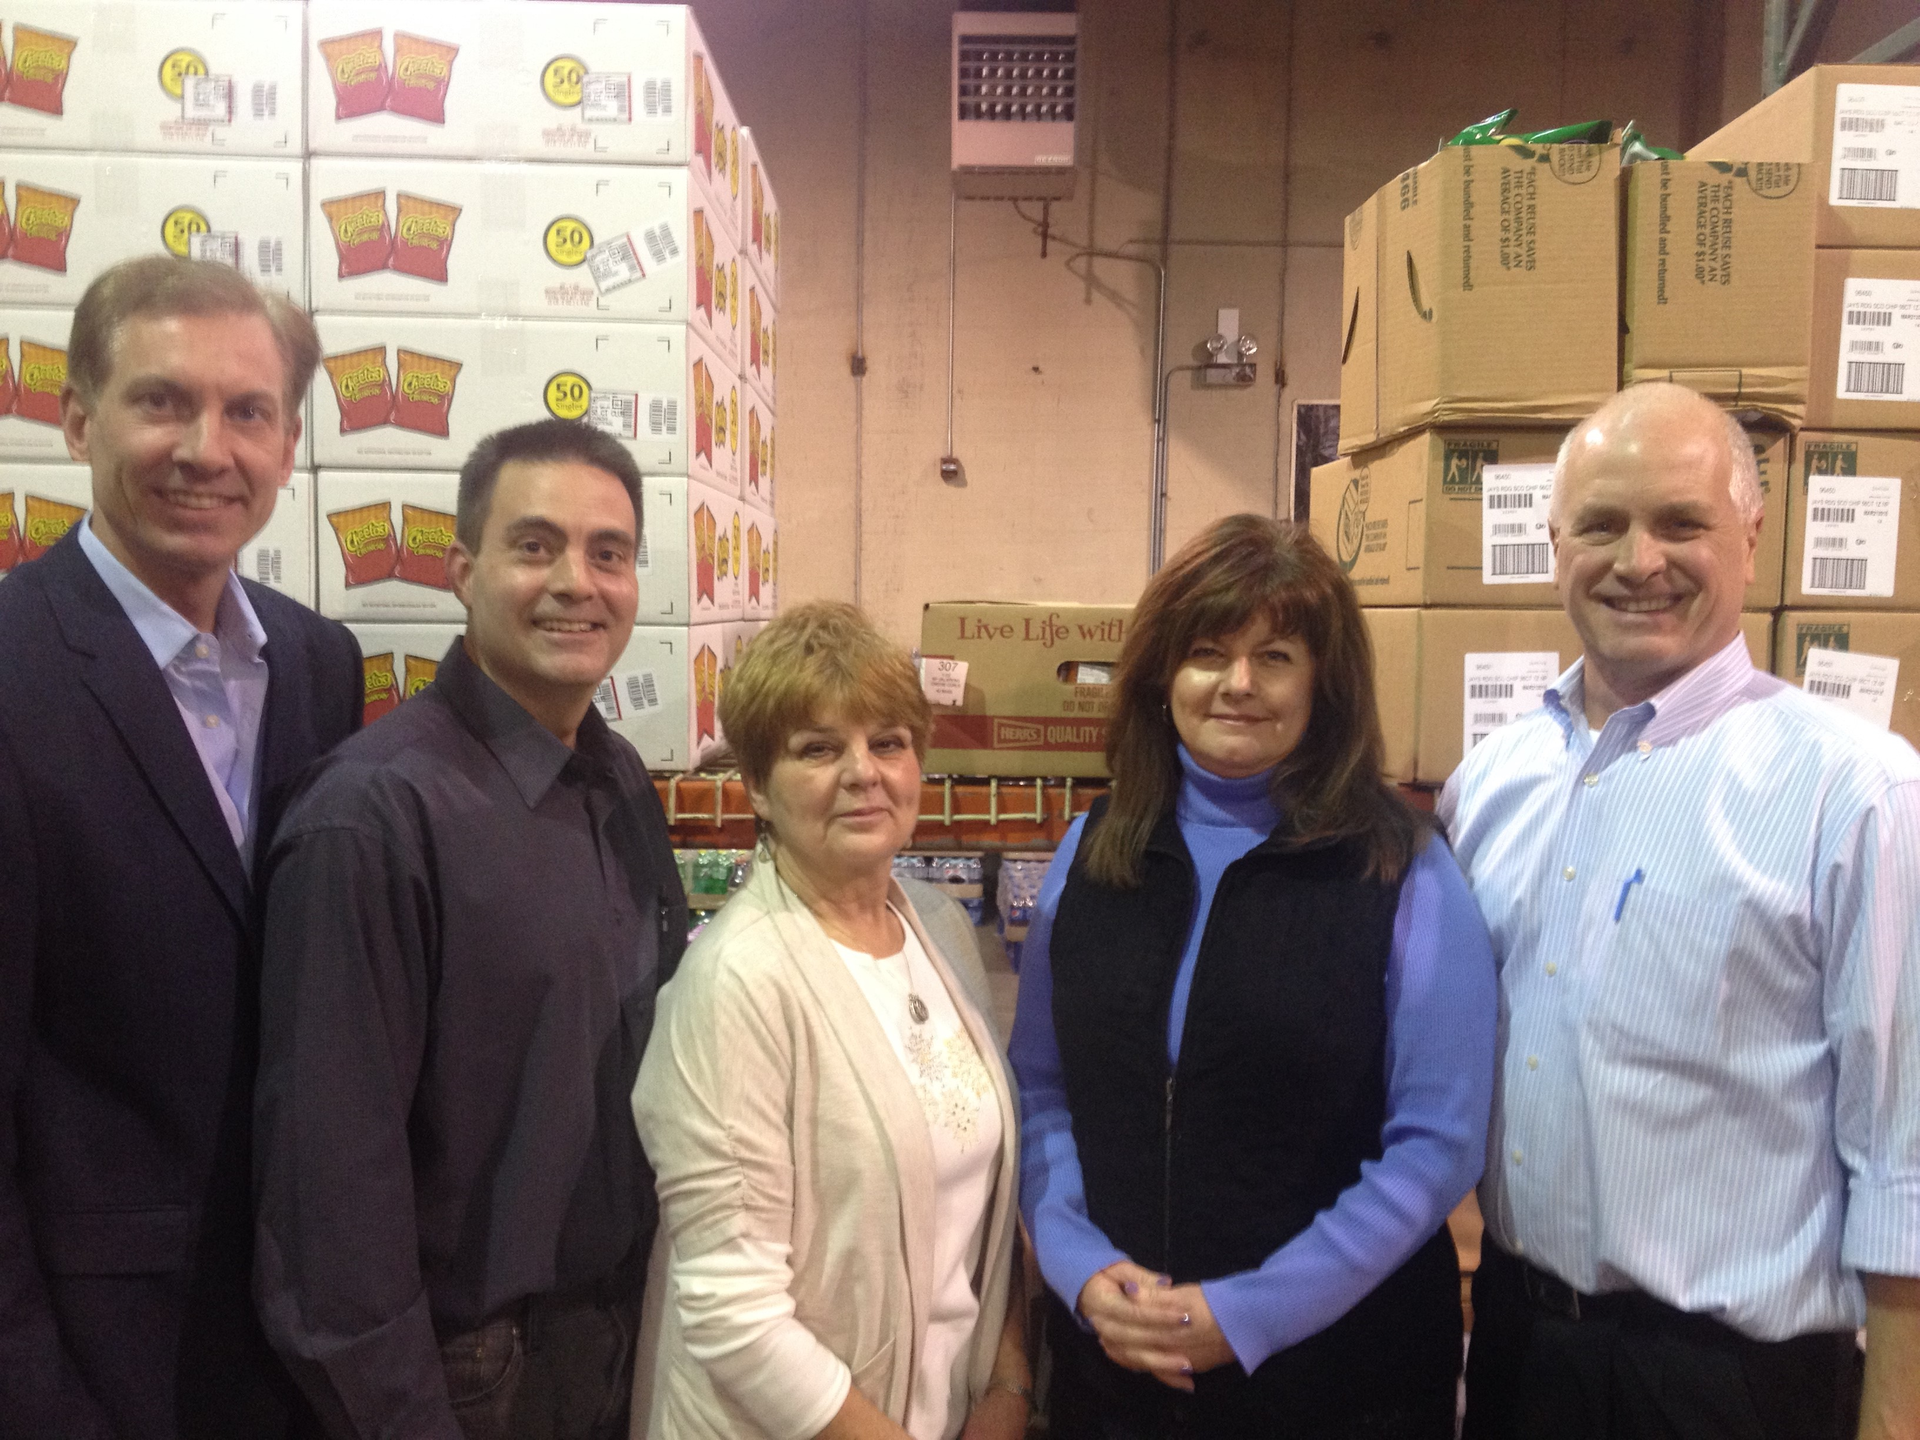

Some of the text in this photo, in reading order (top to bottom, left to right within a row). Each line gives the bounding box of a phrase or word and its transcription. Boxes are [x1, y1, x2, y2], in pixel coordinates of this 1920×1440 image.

[552, 65, 581, 88] 50
[1463, 164, 1474, 177] be
[1764, 168, 1773, 190] SEND
[1500, 167, 1511, 216] AVERAGE
[1660, 178, 1671, 191] be
[1463, 179, 1474, 221] bundled
[1696, 180, 1708, 231] AVERAGE
[1513, 169, 1524, 268] THE COMPANY AN
[1526, 204, 1536, 237] REUSE
[1659, 193, 1671, 235] bundled
[555, 225, 583, 249] 50
[1463, 223, 1474, 243] and
[1500, 218, 1510, 235] OF
[1707, 183, 1721, 282] THE COMPANY AN
[1721, 218, 1733, 251] REUSE
[1658, 236, 1669, 256] and
[1696, 233, 1707, 248] OF
[1525, 239, 1536, 271] SAVES
[1463, 244, 1474, 291] returned!
[1720, 254, 1732, 286] SAVES
[1657, 258, 1668, 305] returned!
[555, 382, 584, 403] 50
[555, 403, 583, 414] Singles
[1446, 441, 1492, 449] FRAGILE
[345, 520, 389, 554] Cheetos
[407, 526, 457, 551] Cheetos
[957, 616, 1014, 640] Live
[1023, 613, 1070, 649] Life
[938, 661, 958, 671] 307
[1063, 701, 1075, 712] DO
[1078, 701, 1095, 713] NOT
[1047, 725, 1098, 744] QUALITY
